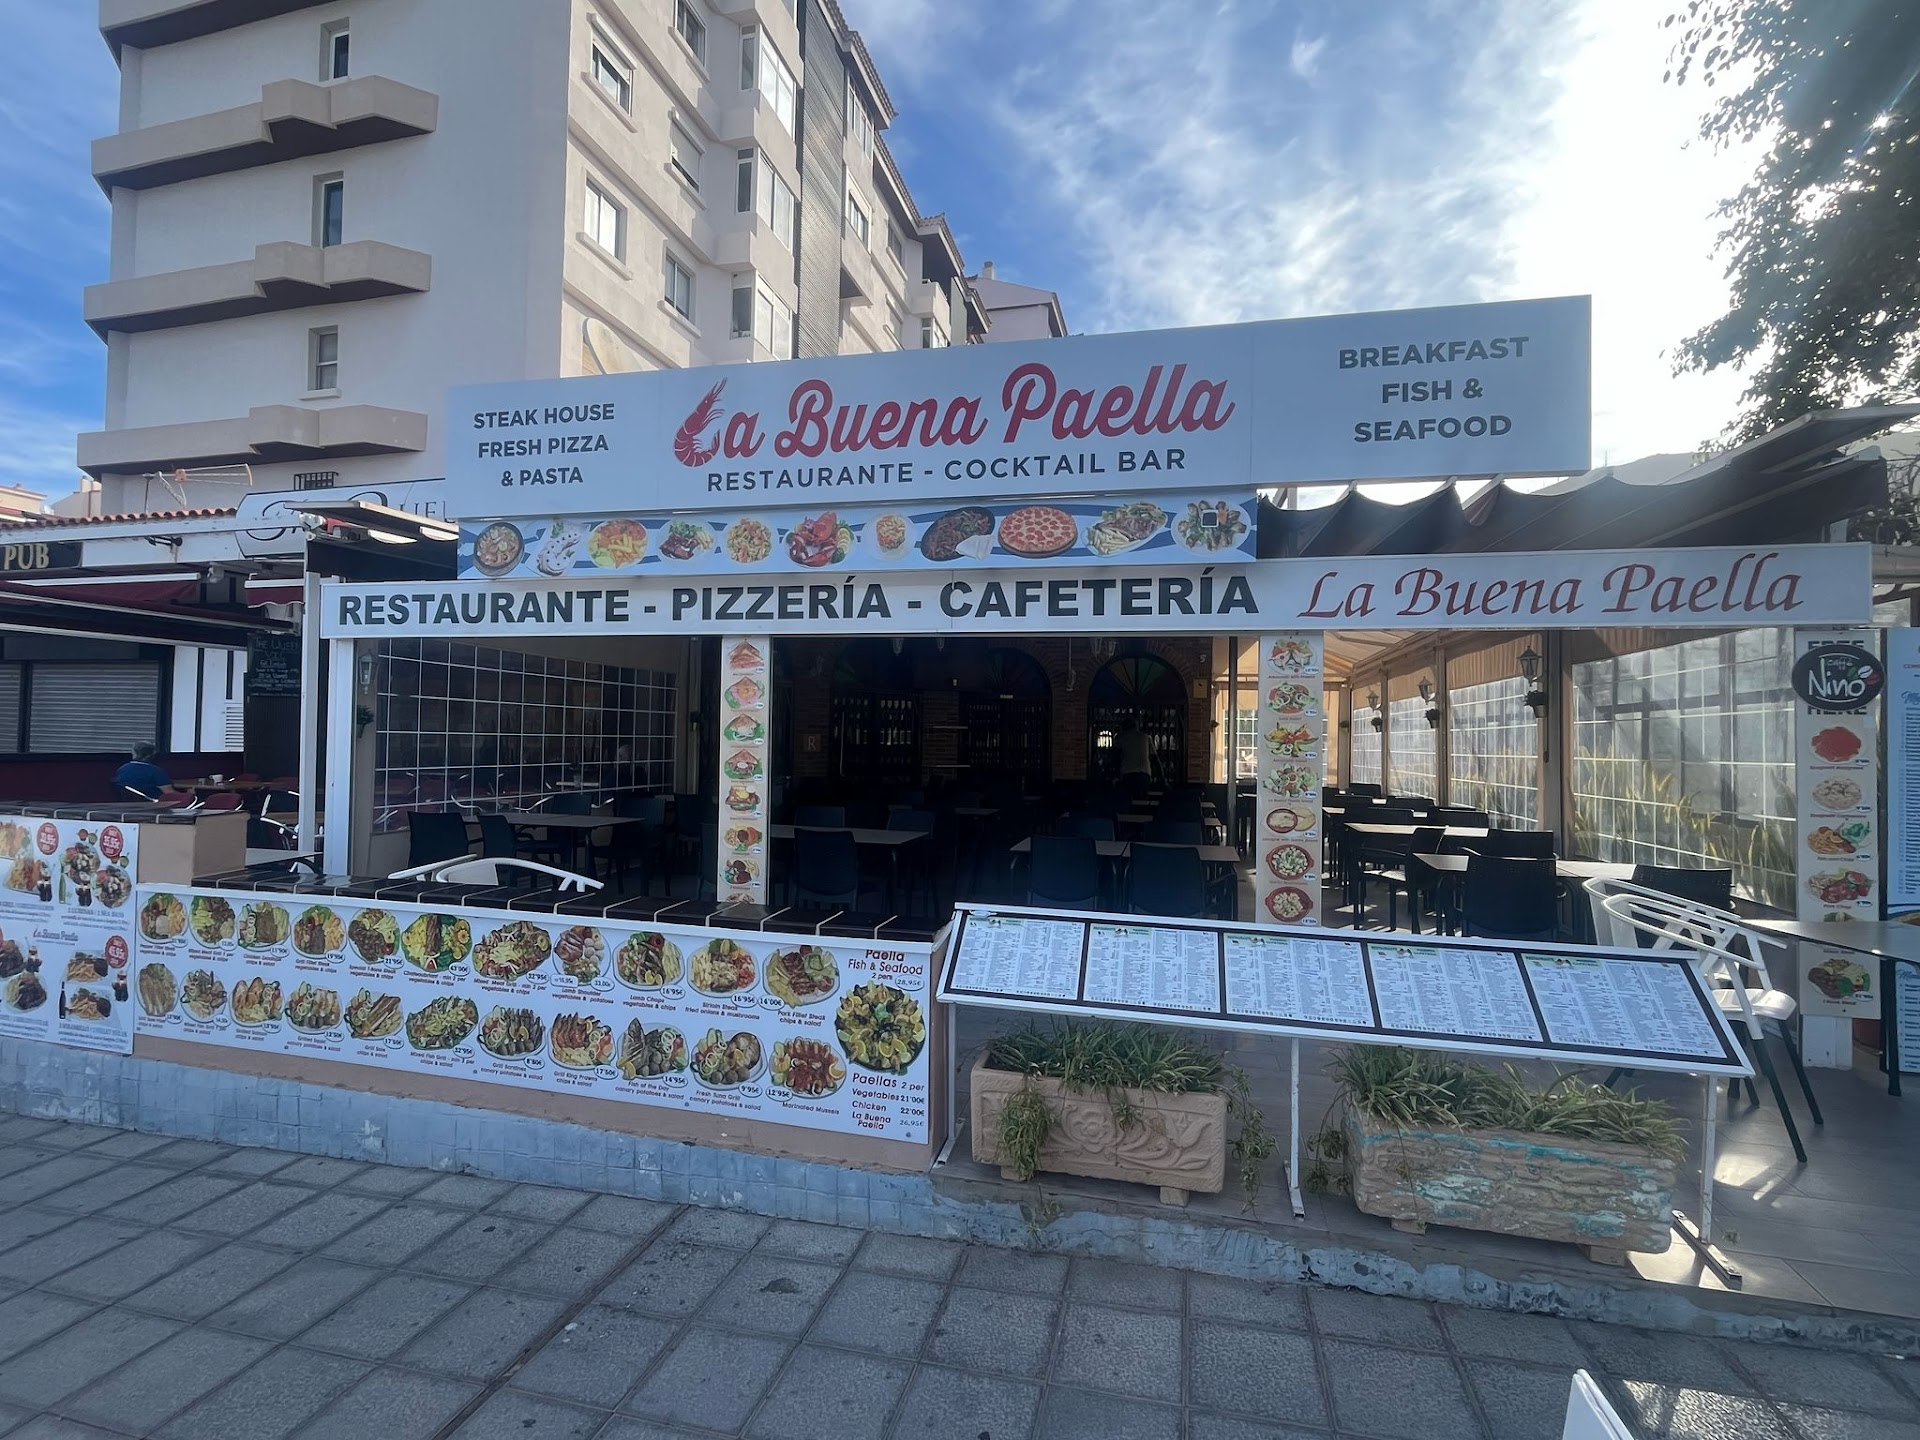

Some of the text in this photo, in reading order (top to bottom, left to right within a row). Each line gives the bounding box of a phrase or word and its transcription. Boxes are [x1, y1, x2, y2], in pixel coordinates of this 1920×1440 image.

[1339, 336, 1529, 369] BREAKFAST
[1382, 377, 1483, 404] FISH &
[474, 403, 615, 429] STEAK HOUSE
[774, 378, 988, 458] Buena
[1002, 362, 1236, 443] Paella
[1354, 415, 1512, 443] SEAFOOD
[478, 434, 609, 458] FRESH PIZZA
[501, 466, 583, 487] & PASTA
[708, 462, 913, 492] RESTAURANTE
[944, 453, 1105, 480] COCKTAIL
[1118, 448, 1186, 472] BAR
[4, 543, 49, 570] PUB
[1296, 552, 1804, 618] La Buena Paella
[339, 567, 1260, 626] RESTAURANTE - PIZZERÍA - CAFETERÍA
[1809, 658, 1866, 697] Nino
[865, 949, 905, 962] Paella
[848, 958, 923, 975] Fish & Seafood
[481, 985, 509, 993] vegetables
[552, 992, 581, 1001] vegetables
[590, 996, 614, 1004] potatoes
[623, 1000, 654, 1009] vegetables
[646, 996, 665, 1004] Chops
[733, 995, 755, 1004] 16'95€
[760, 997, 782, 1007] 14'00€
[722, 1003, 738, 1011] Steak
[700, 1008, 718, 1016] onions
[726, 1011, 760, 1020] mushrooms
[777, 1009, 826, 1021] Pork Fillet Steak
[779, 1017, 797, 1025] chips
[803, 1018, 822, 1027] salad
[556, 1077, 571, 1085] chips
[665, 1076, 685, 1084] 14'95€
[852, 1072, 925, 1094] Paellas 2 per
[614, 1086, 635, 1094] canary
[636, 1088, 661, 1097] potatoes
[668, 1092, 684, 1100] salad
[658, 1084, 670, 1092] Day
[740, 1084, 760, 1094] 9'95€
[767, 1089, 791, 1099] 12'95€
[696, 1089, 741, 1101] Fresh Tuna Grill
[852, 1088, 925, 1105] Vegetables 21'00€
[689, 1095, 710, 1105] canary
[711, 1097, 737, 1107] potatoes
[744, 1102, 761, 1110] salad
[782, 1101, 840, 1115] Marinated Mussels
[852, 1100, 925, 1117] Chicken 22'00€
[852, 1111, 863, 1120] La
[865, 1112, 891, 1123] Buena
[858, 1119, 884, 1130] Paella
